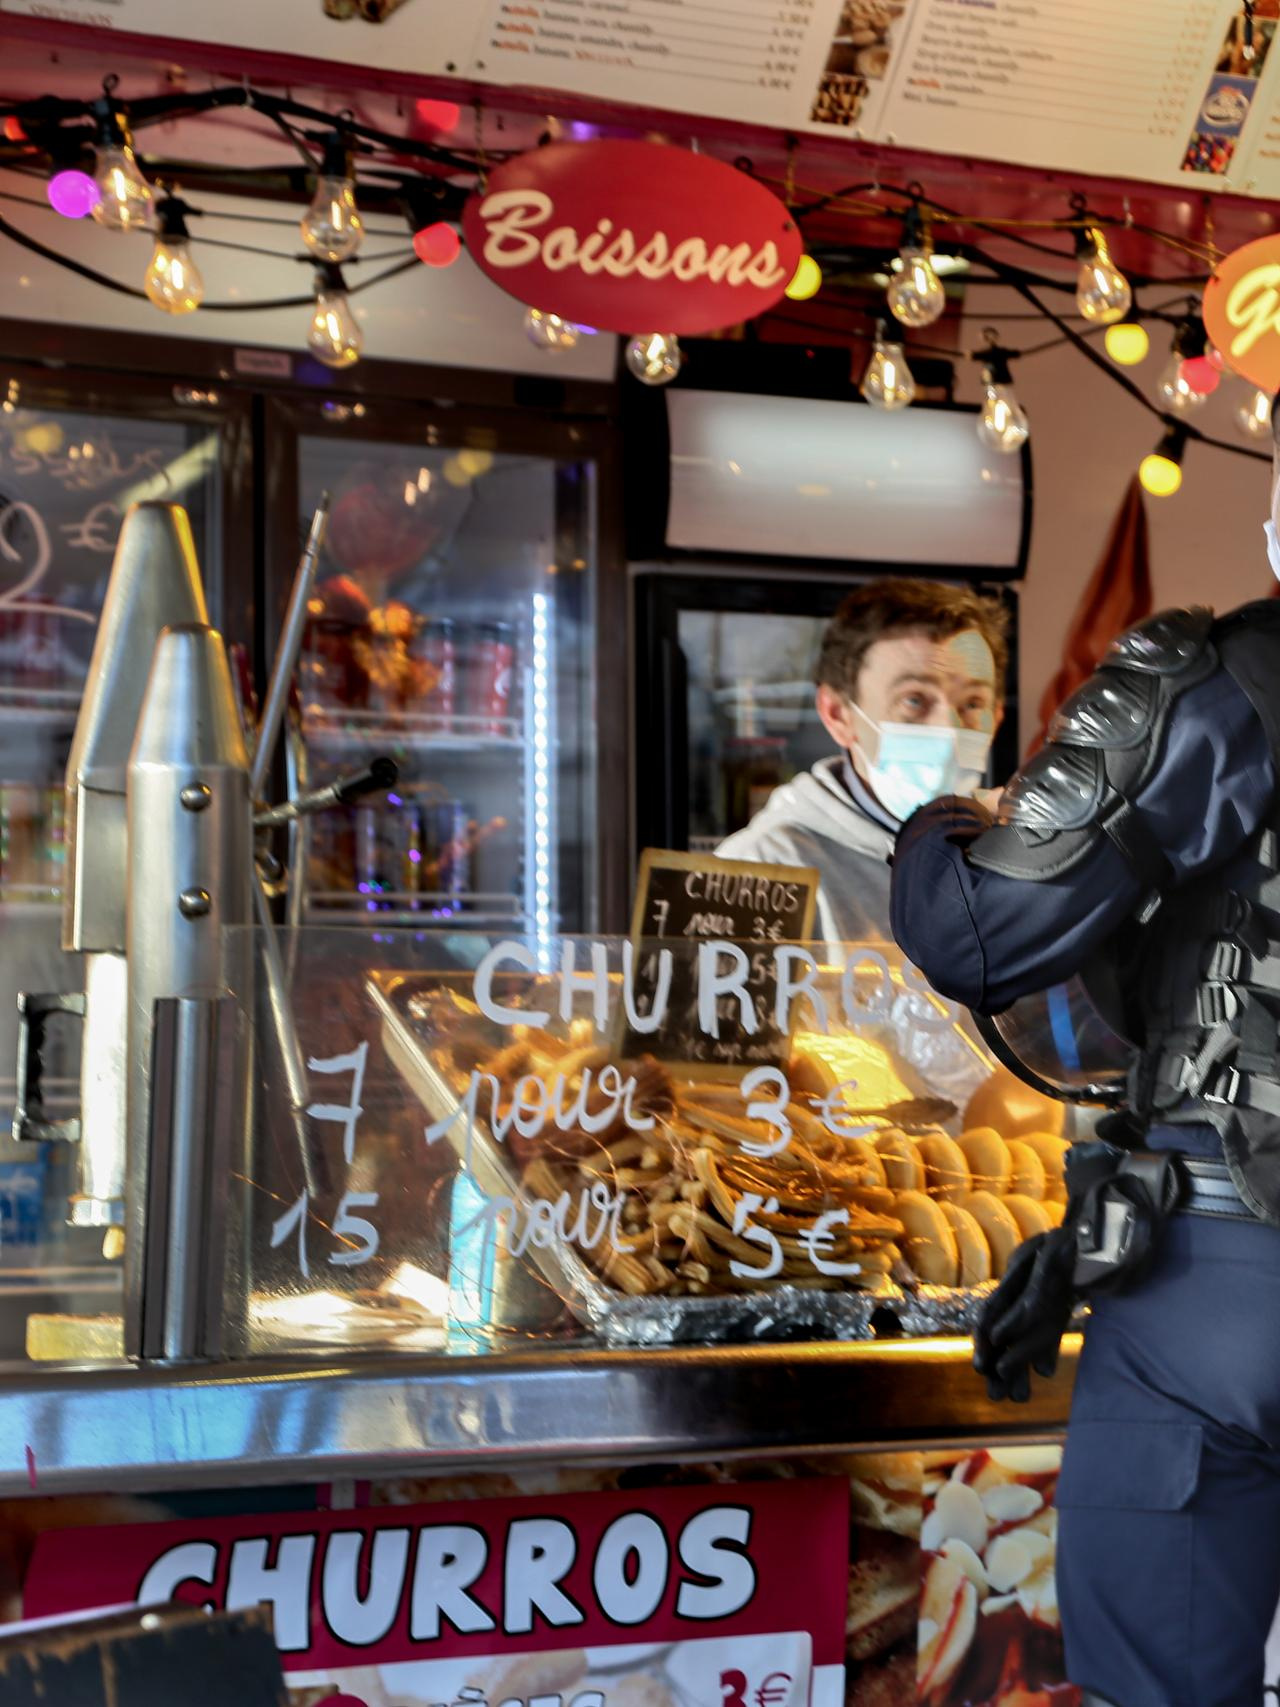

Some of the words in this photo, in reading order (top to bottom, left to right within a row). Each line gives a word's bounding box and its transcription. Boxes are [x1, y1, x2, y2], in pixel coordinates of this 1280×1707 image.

[478, 190, 785, 289] Boissons
[652, 899, 670, 939] 7
[685, 871, 799, 914] CHURROS
[307, 1041, 369, 1165] 7
[425, 1064, 657, 1169] pour
[270, 1187, 381, 1279] 15
[451, 1180, 637, 1300] pour
[137, 1504, 758, 1652] CHURROS
